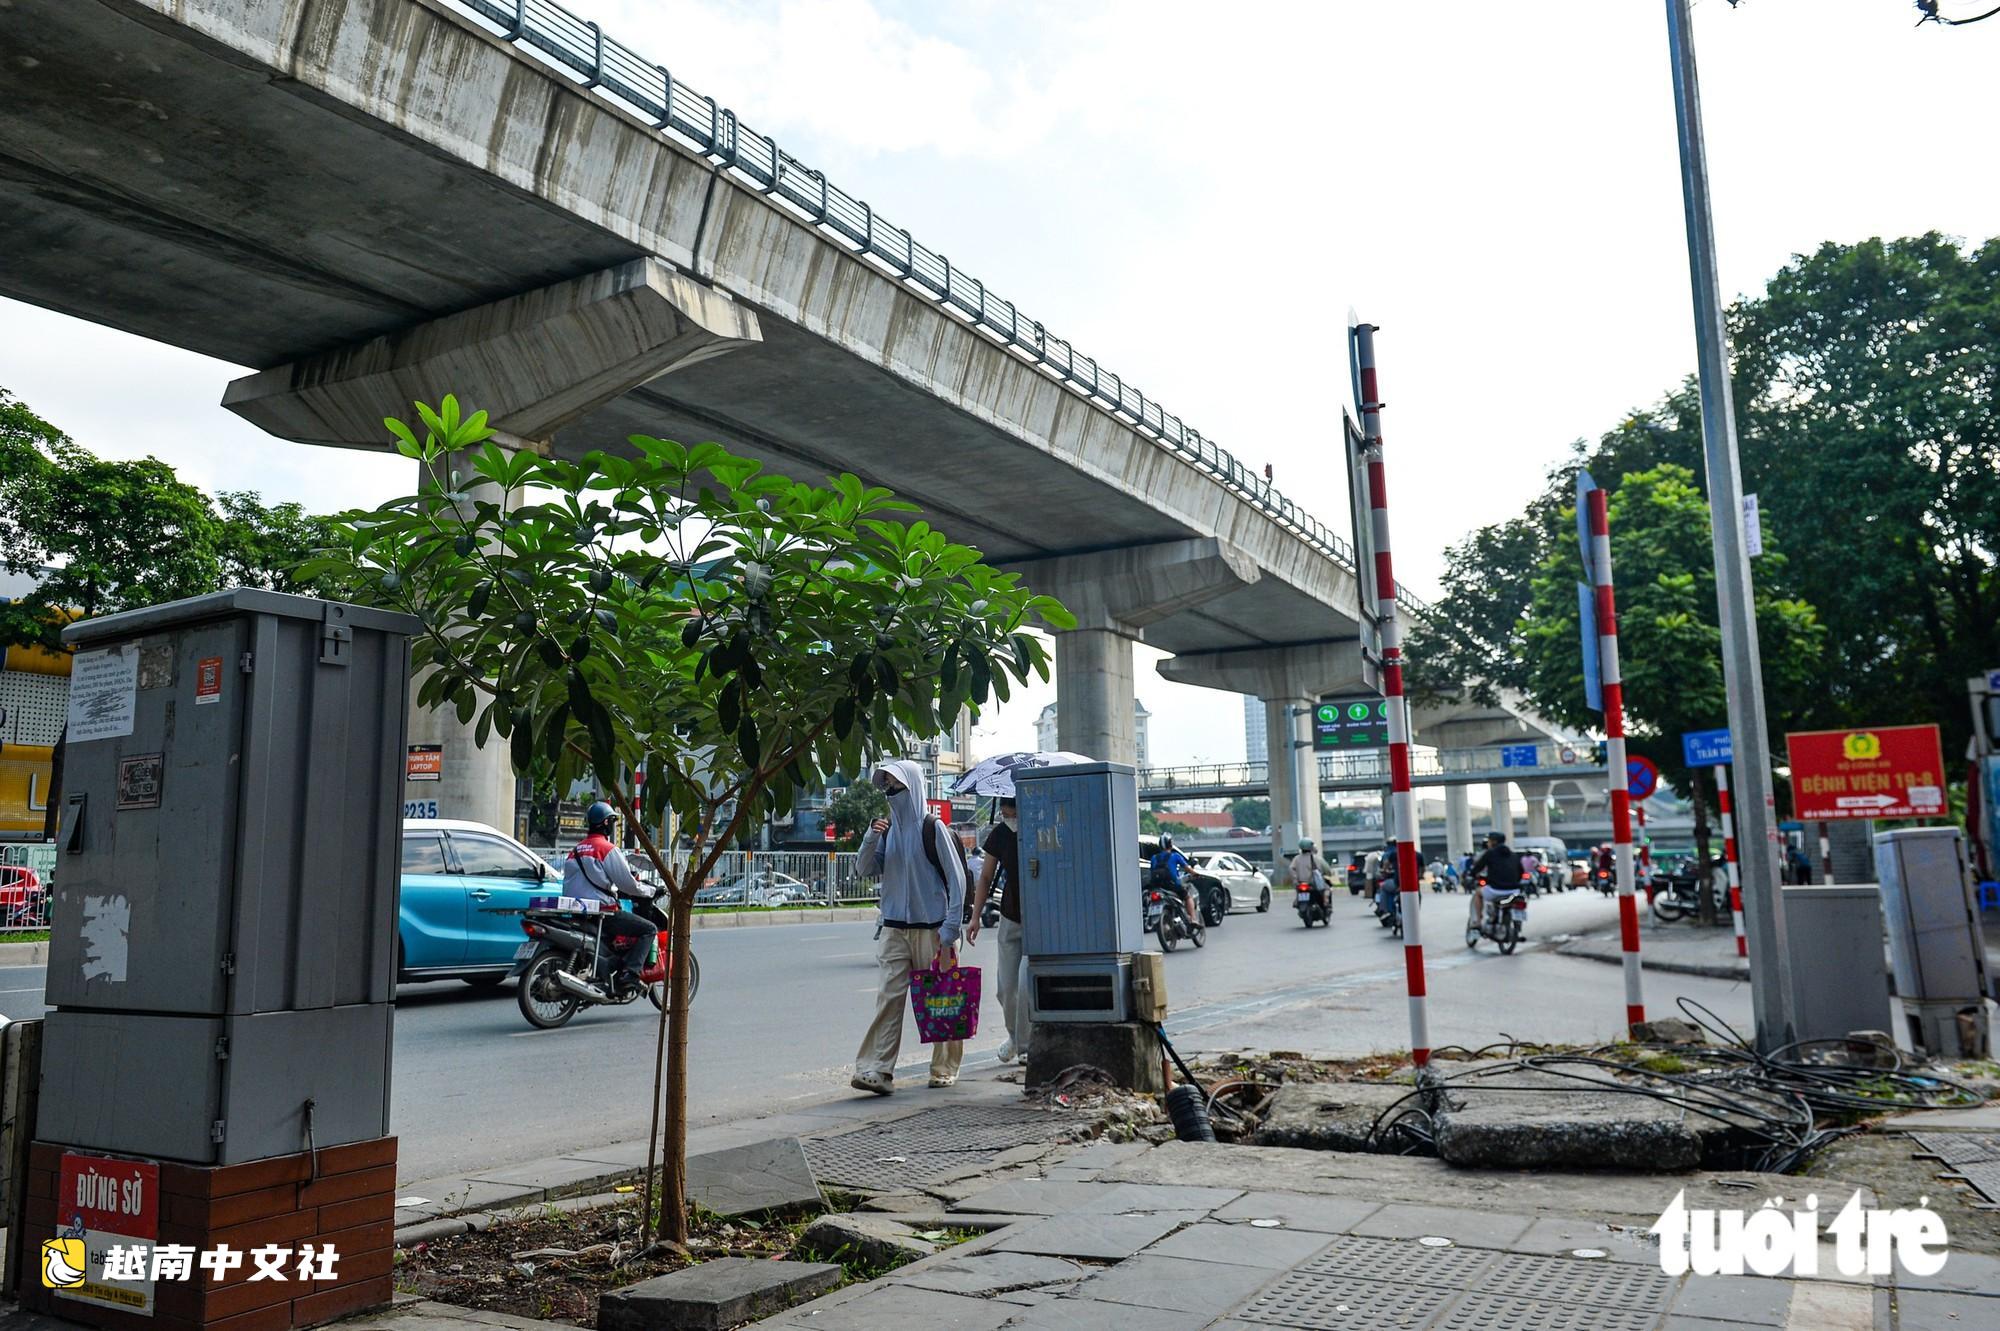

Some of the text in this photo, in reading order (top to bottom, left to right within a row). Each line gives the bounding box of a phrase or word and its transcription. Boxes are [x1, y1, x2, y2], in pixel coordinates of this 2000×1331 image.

[410, 763, 433, 771] LAPTOP
[1802, 771, 1934, 795] BỆNH VIỆN 19-8
[929, 1006, 961, 1017] TRUST
[77, 1166, 143, 1216] ĐỪNG SỜ
